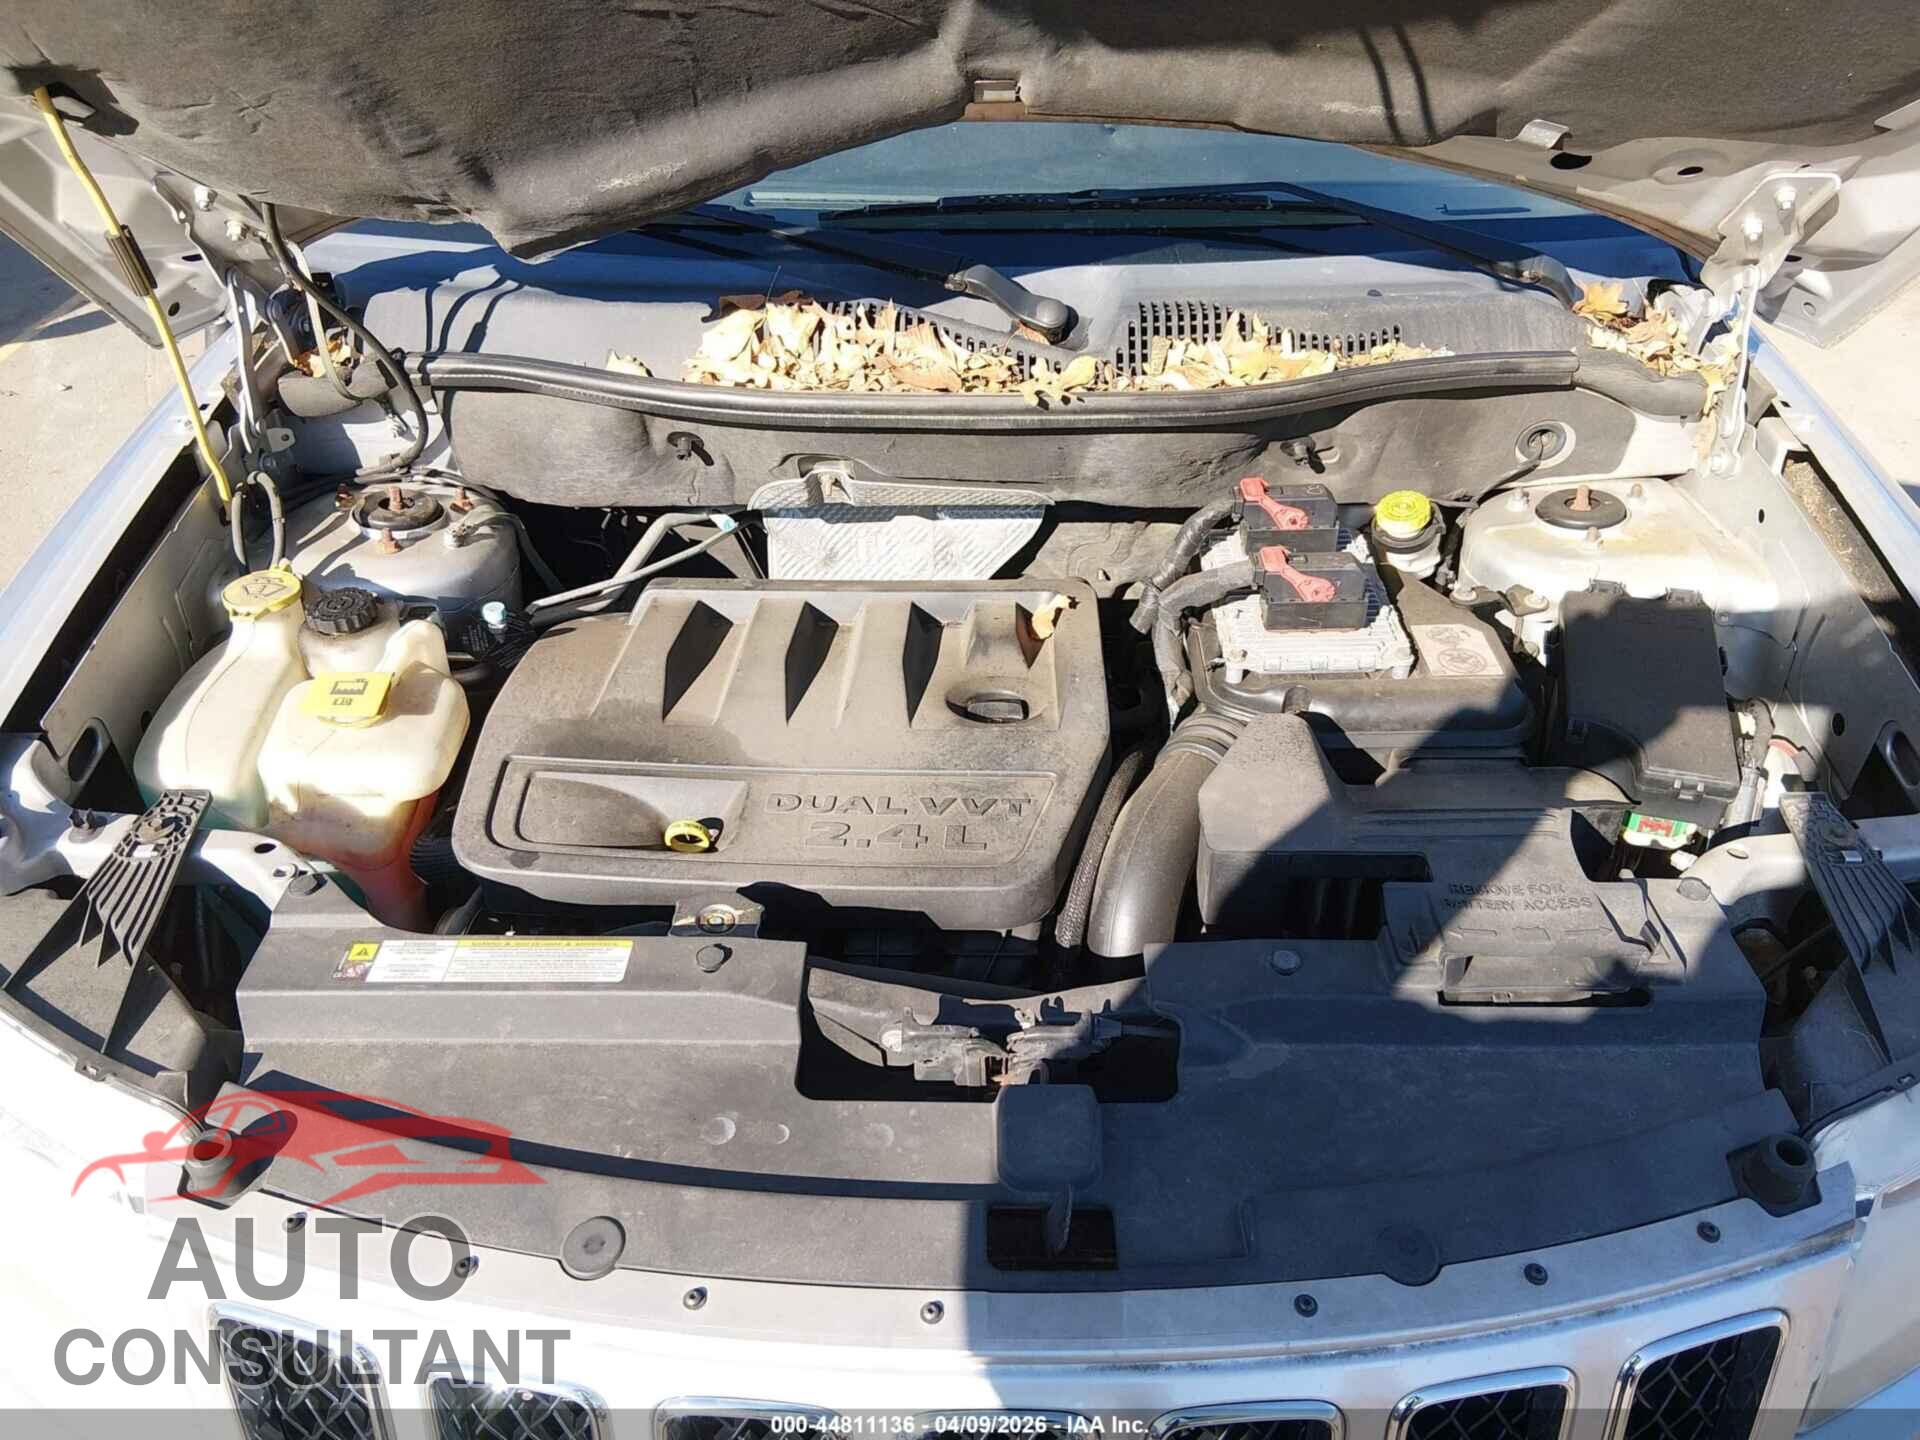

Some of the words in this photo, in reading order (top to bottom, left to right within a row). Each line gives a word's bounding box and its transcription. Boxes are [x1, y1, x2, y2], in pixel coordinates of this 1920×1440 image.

[764, 793, 908, 816] DUAL
[919, 796, 1032, 817] VVT
[1523, 896, 1594, 912] ACCESS
